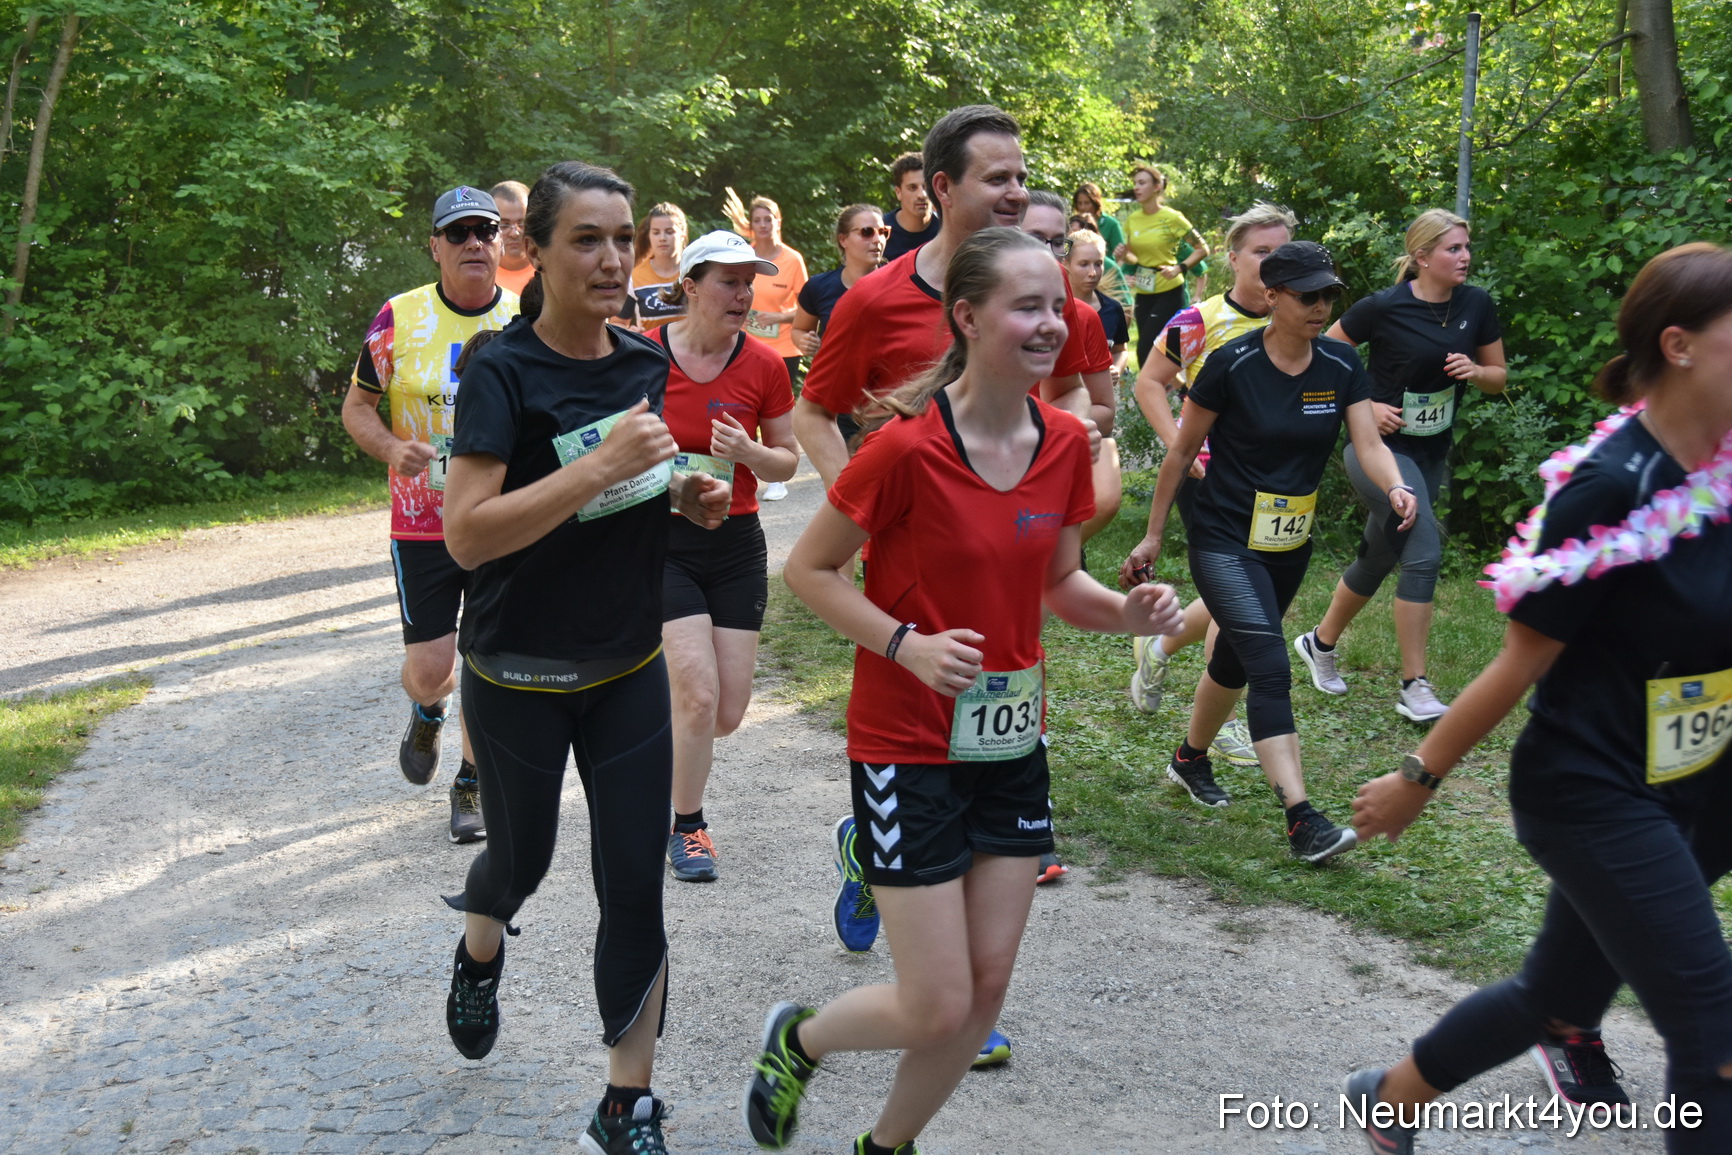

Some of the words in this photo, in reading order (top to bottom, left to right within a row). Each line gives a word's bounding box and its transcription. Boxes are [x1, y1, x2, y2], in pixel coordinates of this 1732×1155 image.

[1415, 405, 1445, 424] 441
[603, 484, 629, 499] Pfanz
[628, 472, 656, 489] Daniela
[1271, 514, 1307, 536] 142
[503, 671, 532, 682] BUILD
[540, 673, 579, 683] FITNESS
[975, 687, 1023, 698] firmenlauf
[970, 695, 1039, 736] 1033
[978, 737, 1016, 746] Schober
